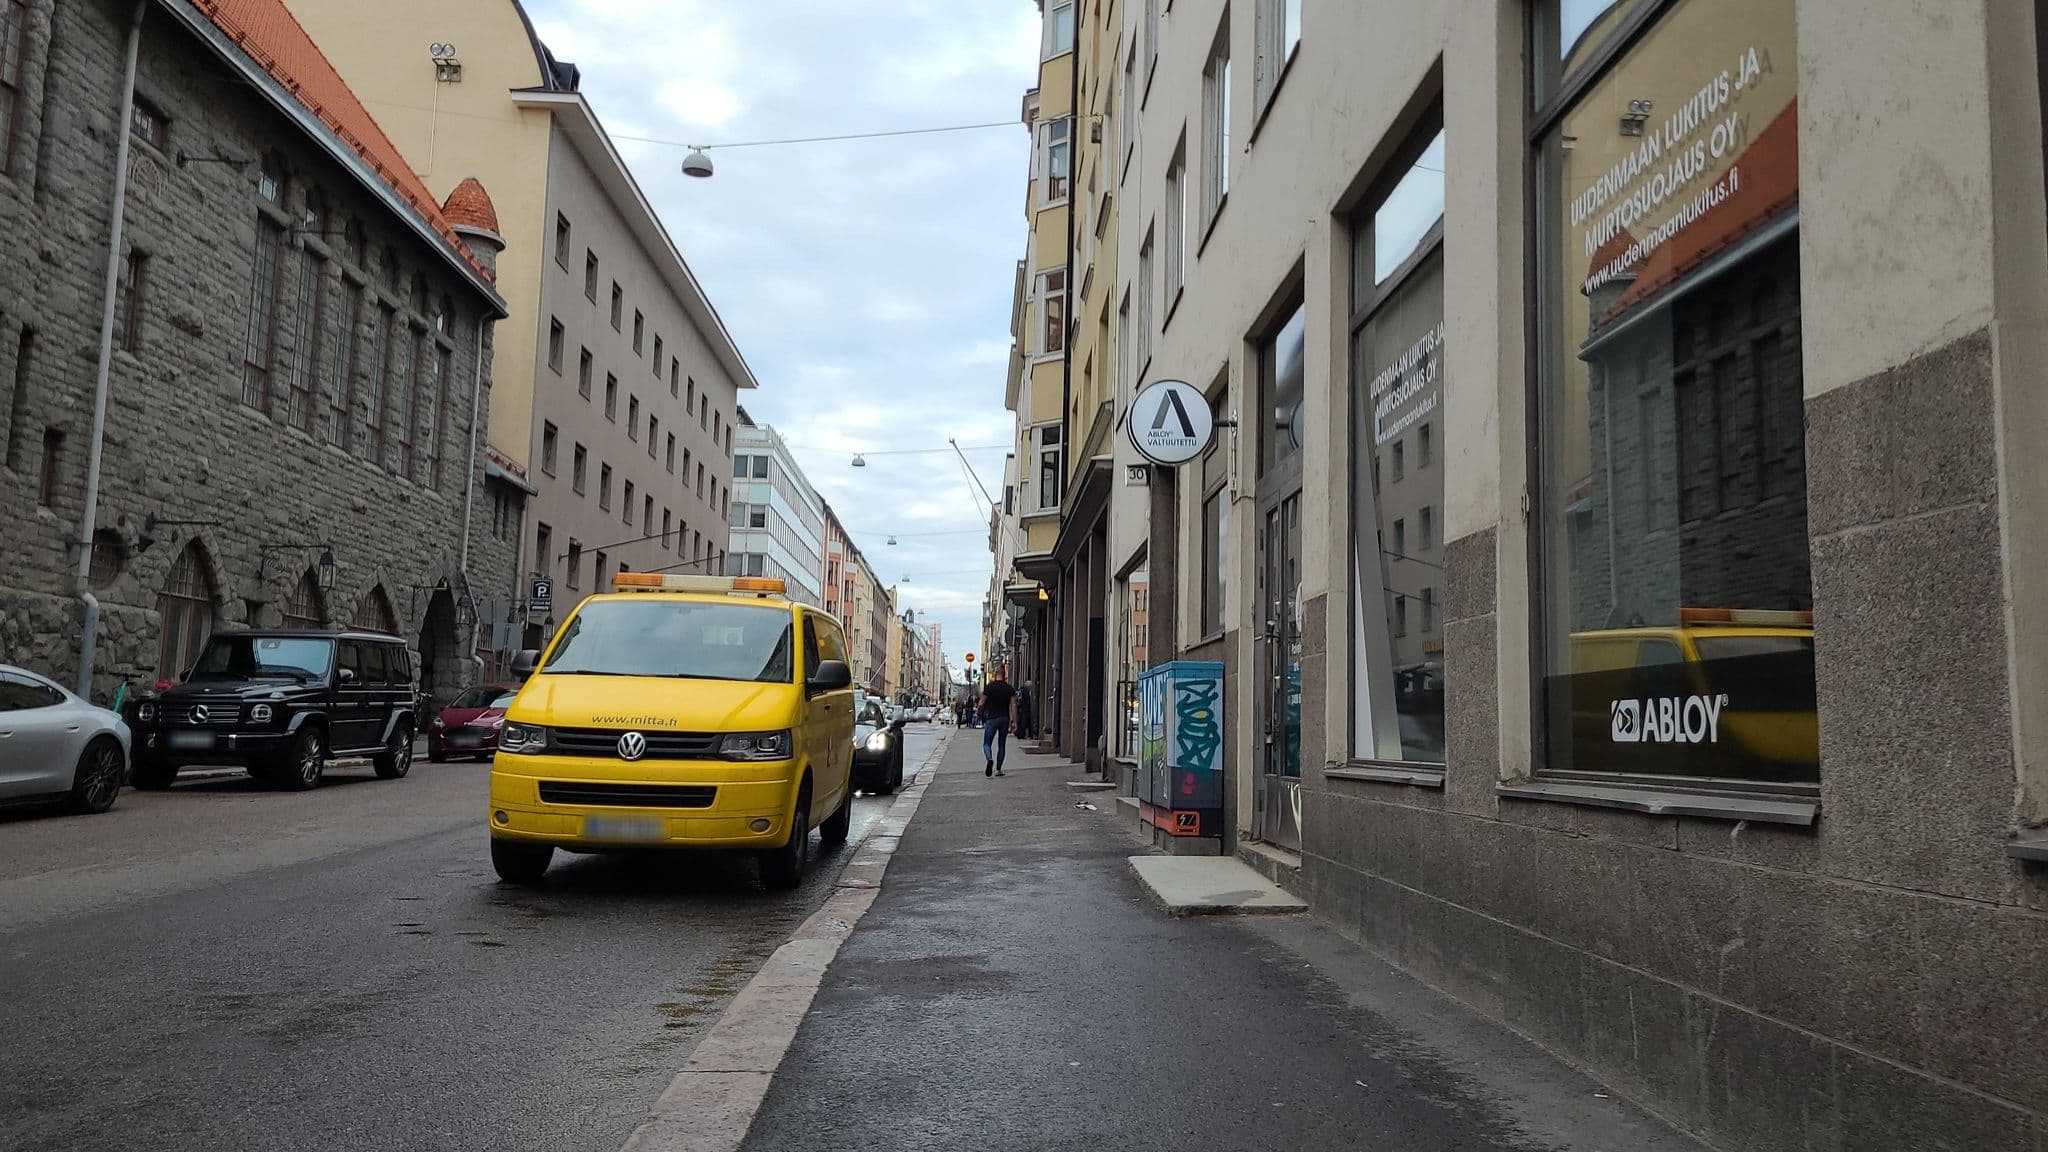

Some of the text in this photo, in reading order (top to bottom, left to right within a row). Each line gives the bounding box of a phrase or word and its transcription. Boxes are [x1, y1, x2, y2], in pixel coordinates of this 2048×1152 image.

[1571, 47, 1760, 226] UUDENMAAN LUKITUS JA
[1585, 112, 1738, 256] MURTOSUOJAUS OY
[1584, 166, 1739, 294] www.uudenmaanlukitus.fi
[1370, 320, 1445, 399] UUDENMAAN LUKITUS JA
[1375, 358, 1437, 418] MURTOSUOJAUS OY
[1129, 469, 1143, 480] 30
[1147, 438, 1197, 446] VALTUUTETTU
[592, 715, 677, 726] www.mitta.fi
